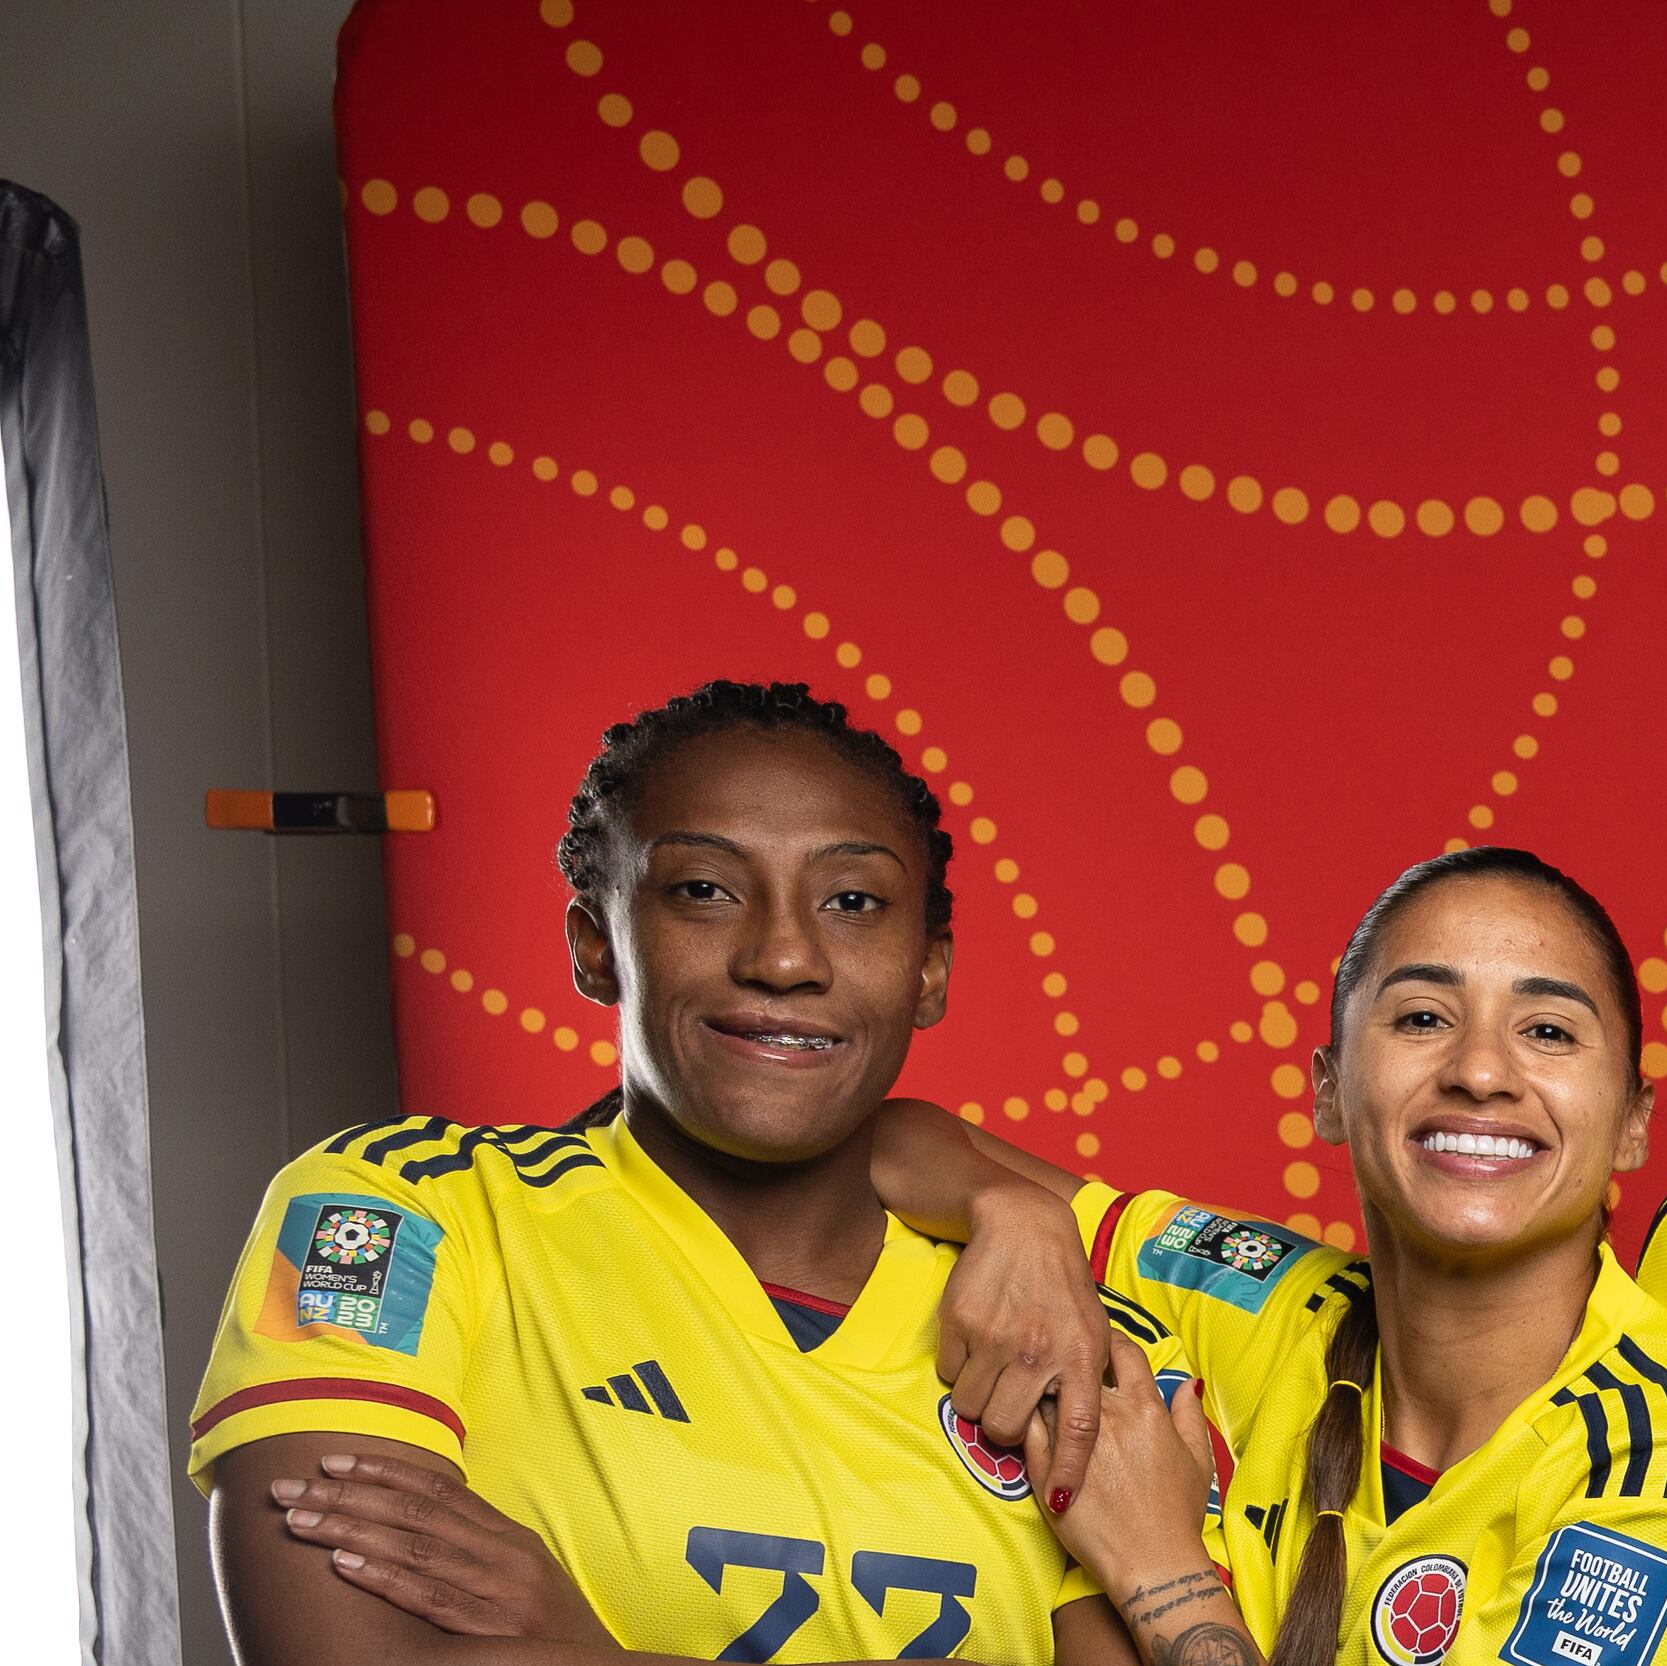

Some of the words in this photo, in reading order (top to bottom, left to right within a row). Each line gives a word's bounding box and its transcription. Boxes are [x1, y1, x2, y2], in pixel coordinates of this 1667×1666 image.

[305, 1265, 333, 1274] FIFA
[302, 1280, 343, 1290] WORLD
[343, 1283, 367, 1292] CUP
[304, 1273, 358, 1284] WOMEN'S
[299, 1293, 334, 1308] AU
[340, 1295, 377, 1314] 20
[300, 1306, 331, 1321] NZ
[1570, 1549, 1649, 1596] FOOTBALL
[1560, 1570, 1643, 1623] UNITES
[1547, 1598, 1575, 1624] the
[1574, 1608, 1637, 1651] World
[1560, 1638, 1593, 1660] FIFA
